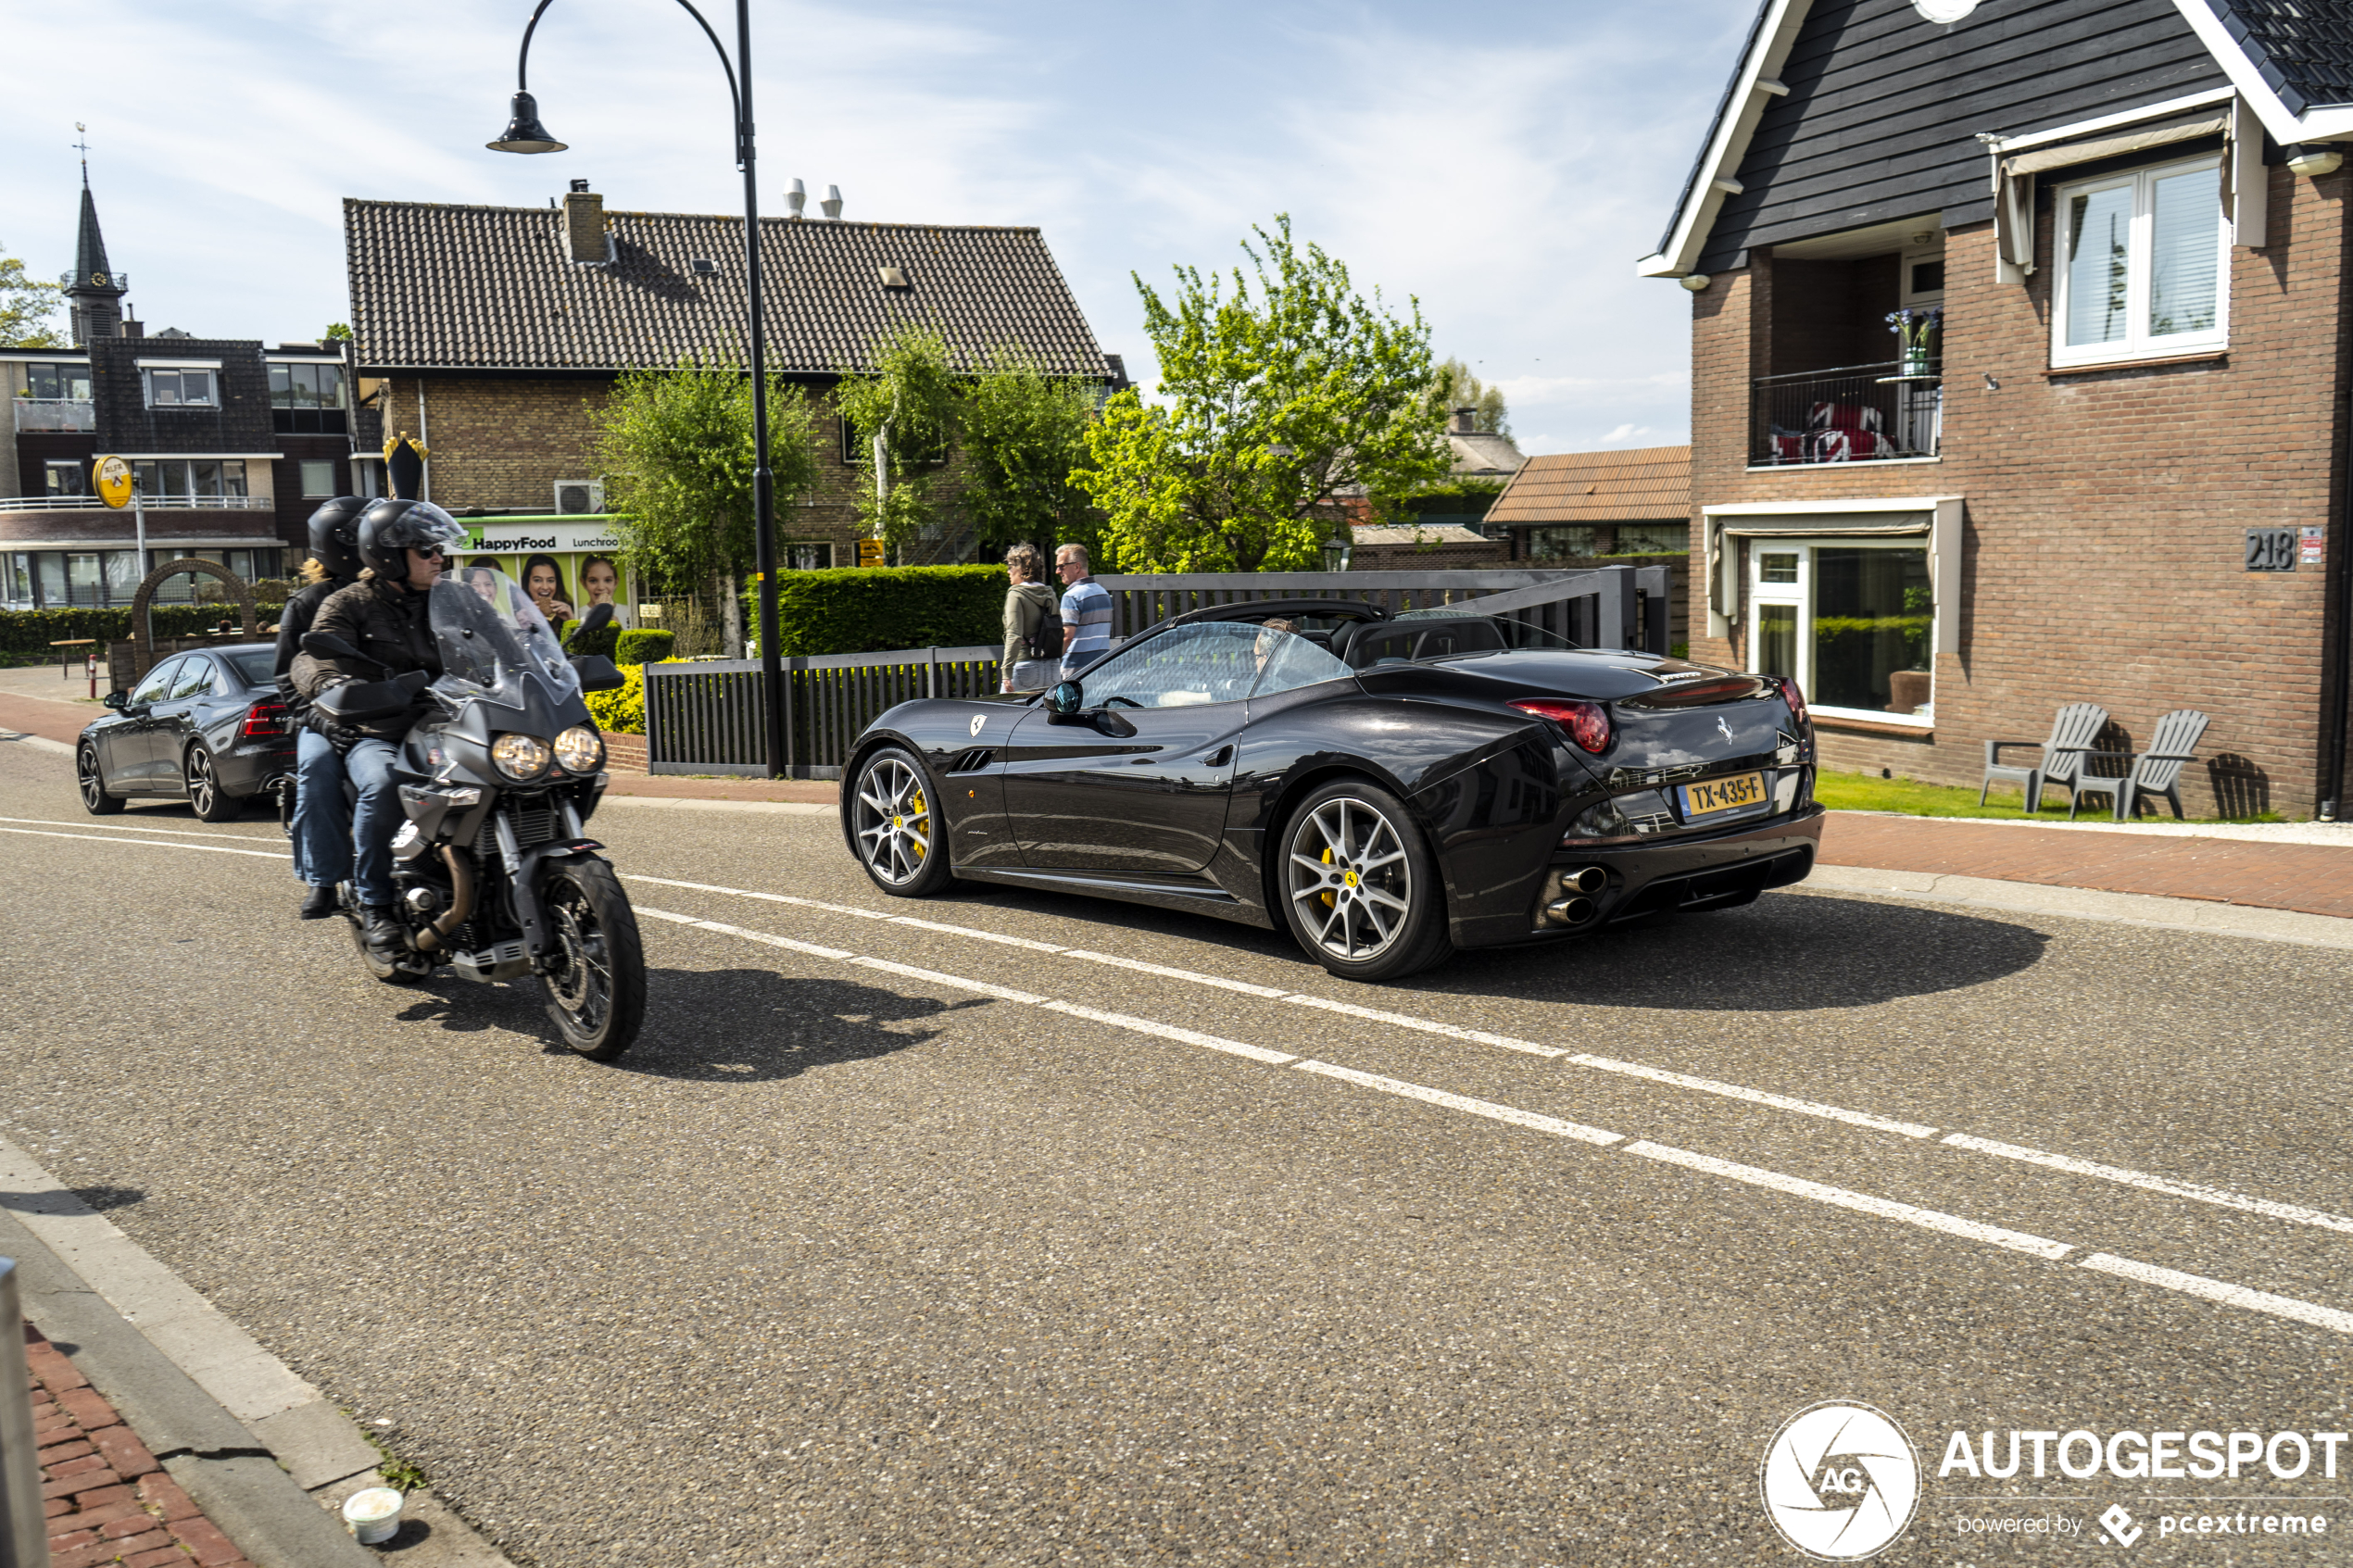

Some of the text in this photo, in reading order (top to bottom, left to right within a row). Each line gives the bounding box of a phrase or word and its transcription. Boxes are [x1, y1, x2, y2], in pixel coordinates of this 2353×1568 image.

[105, 463, 123, 473] ALFA
[473, 536, 618, 551] HappyFood Lunchroo
[2247, 530, 2294, 570] 218
[1692, 776, 1758, 809] TX-435-F
